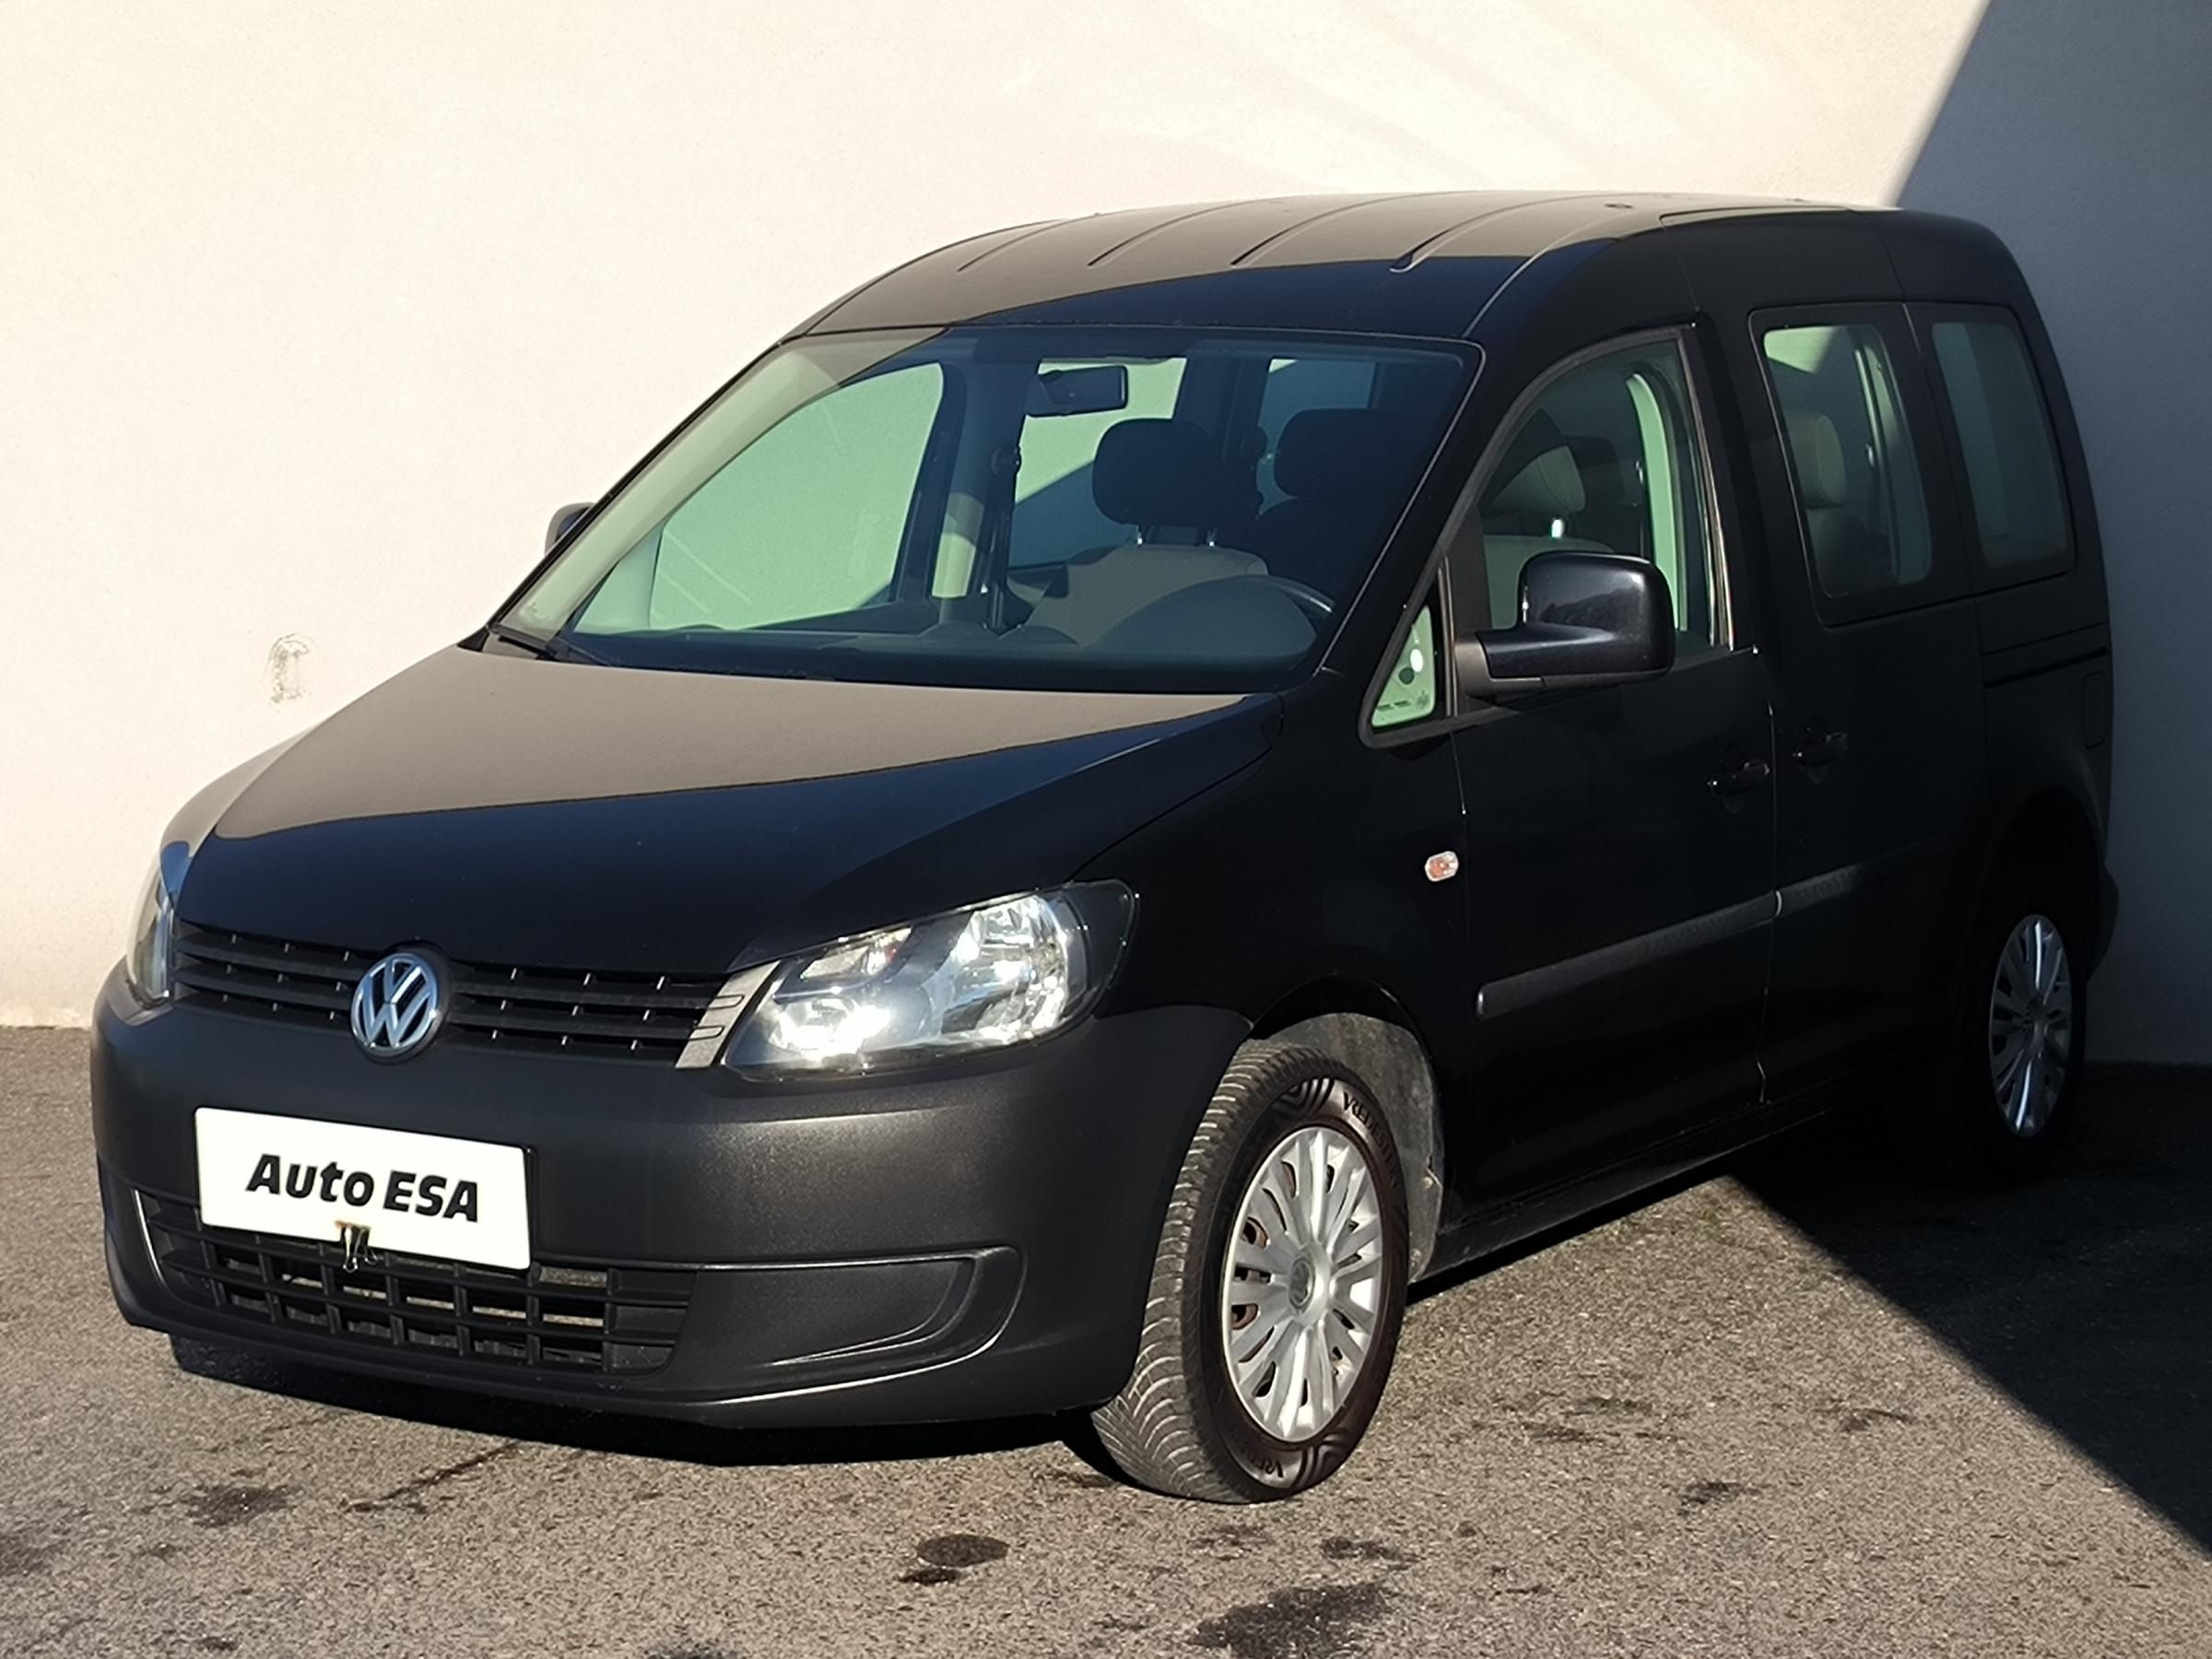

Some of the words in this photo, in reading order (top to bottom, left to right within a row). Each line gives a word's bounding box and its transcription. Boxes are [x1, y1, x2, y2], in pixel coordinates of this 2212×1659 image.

[354, 955, 435, 1053] VW
[245, 1153, 375, 1208] Auto
[382, 1170, 479, 1224] ESA
